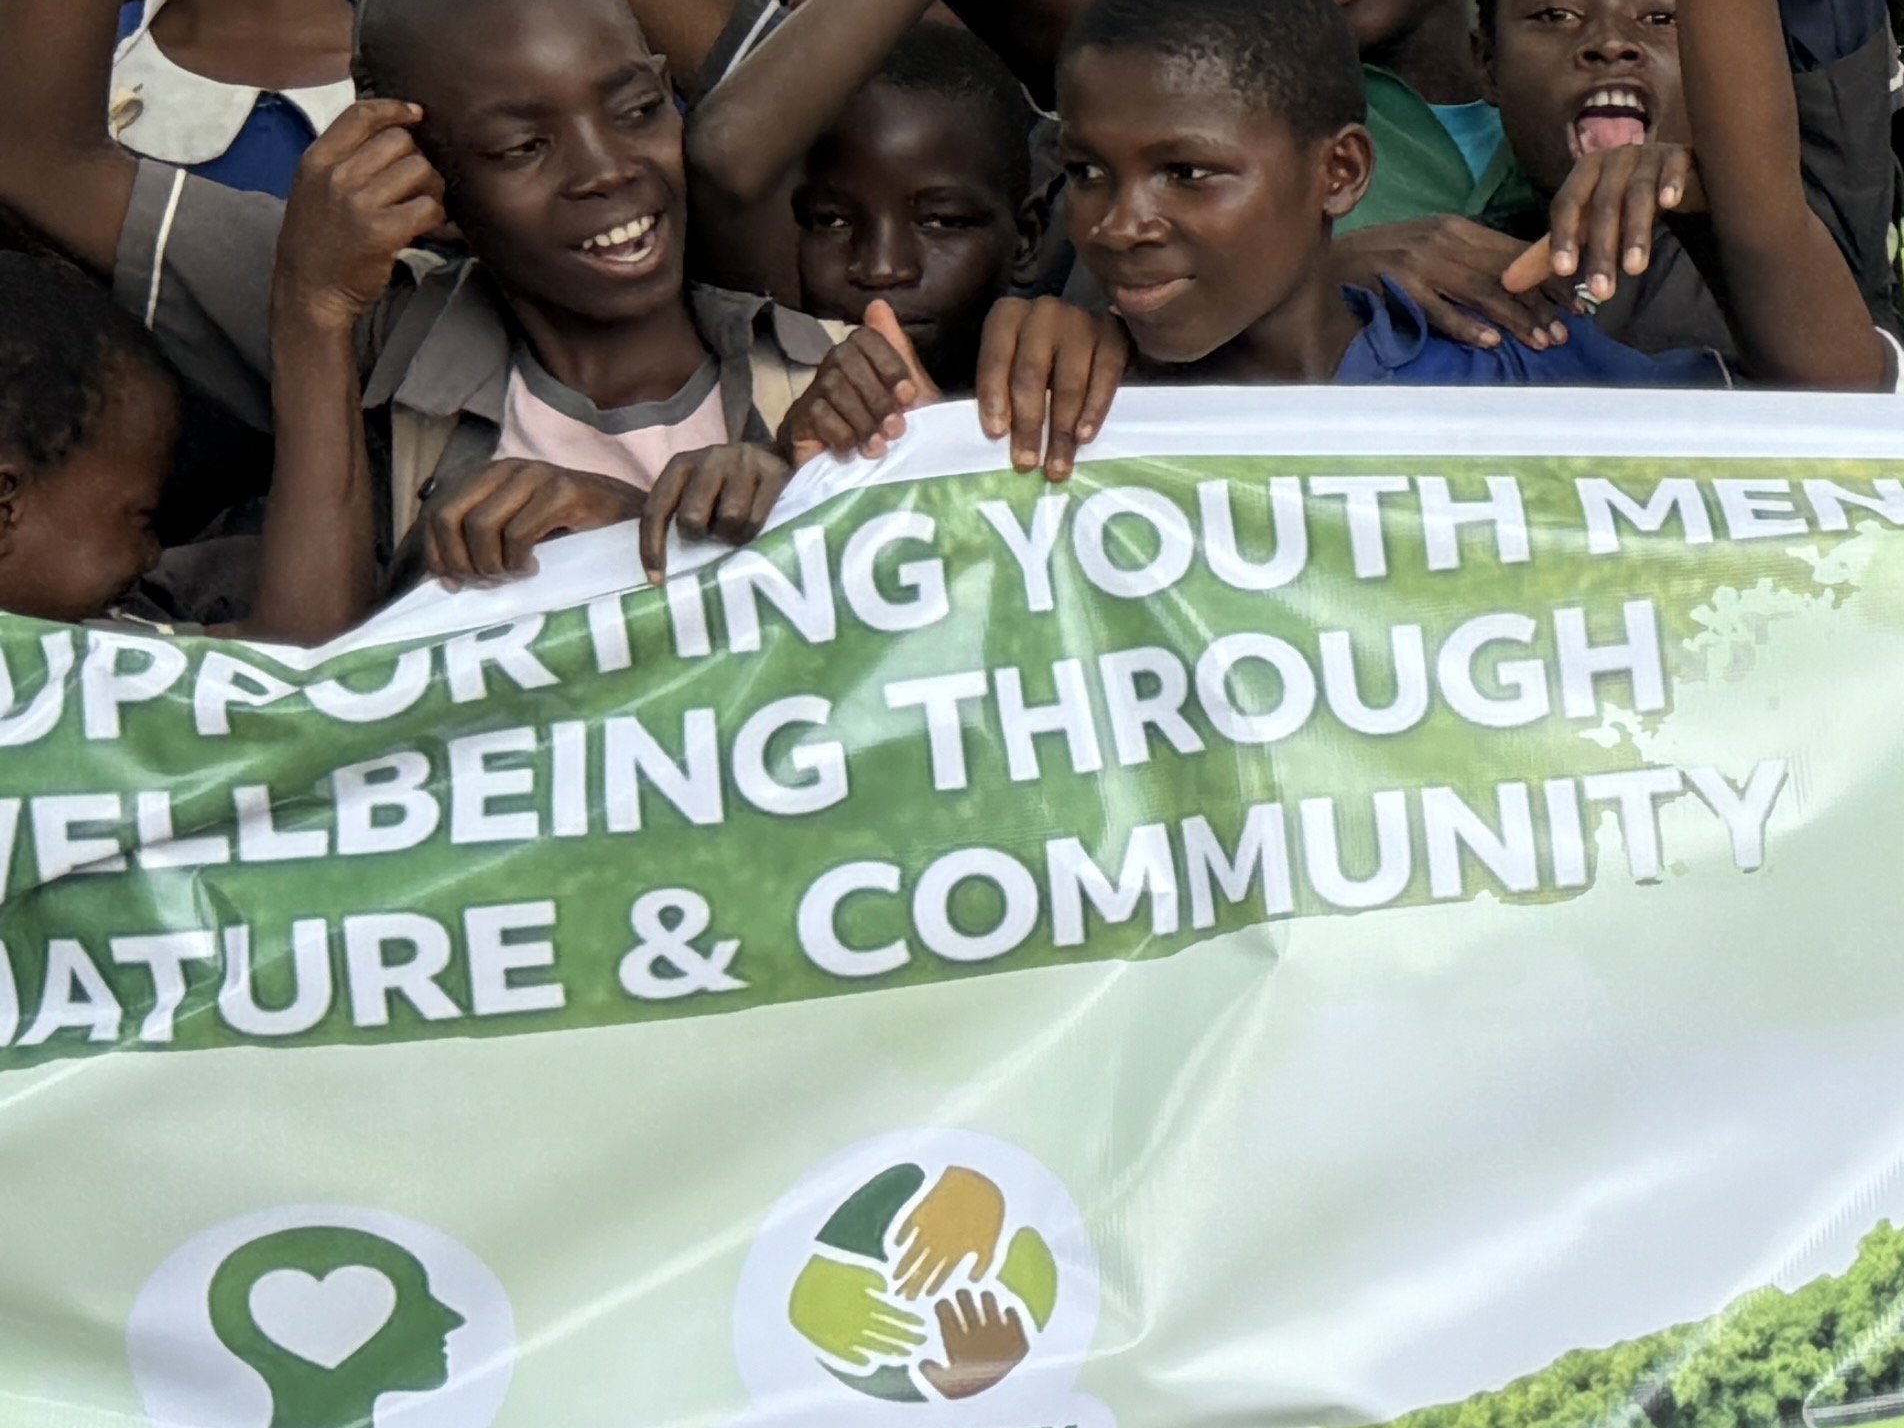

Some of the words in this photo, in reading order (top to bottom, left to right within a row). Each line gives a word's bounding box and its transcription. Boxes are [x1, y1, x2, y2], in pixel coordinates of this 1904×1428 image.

[978, 475, 1530, 612] YOUTH
[0, 694, 849, 905] ELLBEING
[885, 598, 1666, 791] THROUGH
[0, 900, 566, 1047] ATURE
[617, 887, 750, 1001] &
[797, 761, 1790, 978] COMMUNITY
